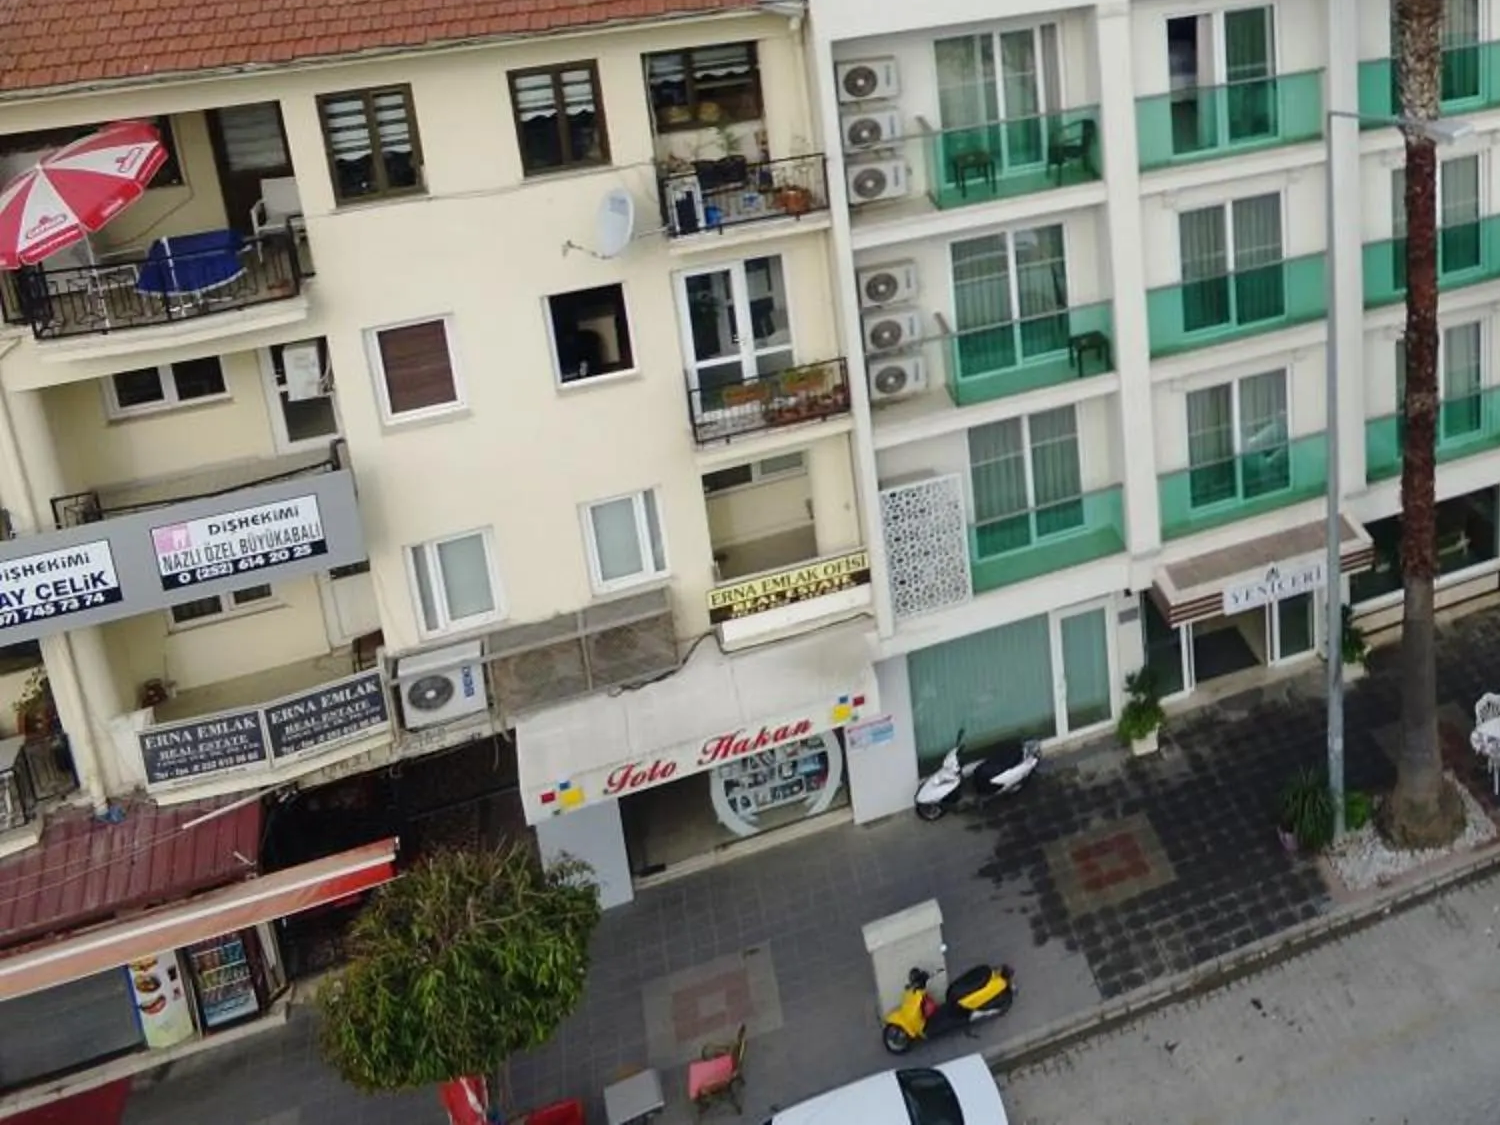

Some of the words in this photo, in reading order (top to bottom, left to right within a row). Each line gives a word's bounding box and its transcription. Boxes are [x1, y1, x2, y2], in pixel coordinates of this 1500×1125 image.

[0, 552, 91, 582] İŞHEKİMİ
[238, 555, 265, 570] 614
[268, 549, 290, 563] 20
[710, 584, 758, 606] ERNA
[761, 567, 818, 593] EMLAK
[23, 602, 56, 620] 745
[145, 730, 193, 750] ERNA
[197, 716, 257, 740] EMLAK
[697, 719, 813, 766] Hakan
